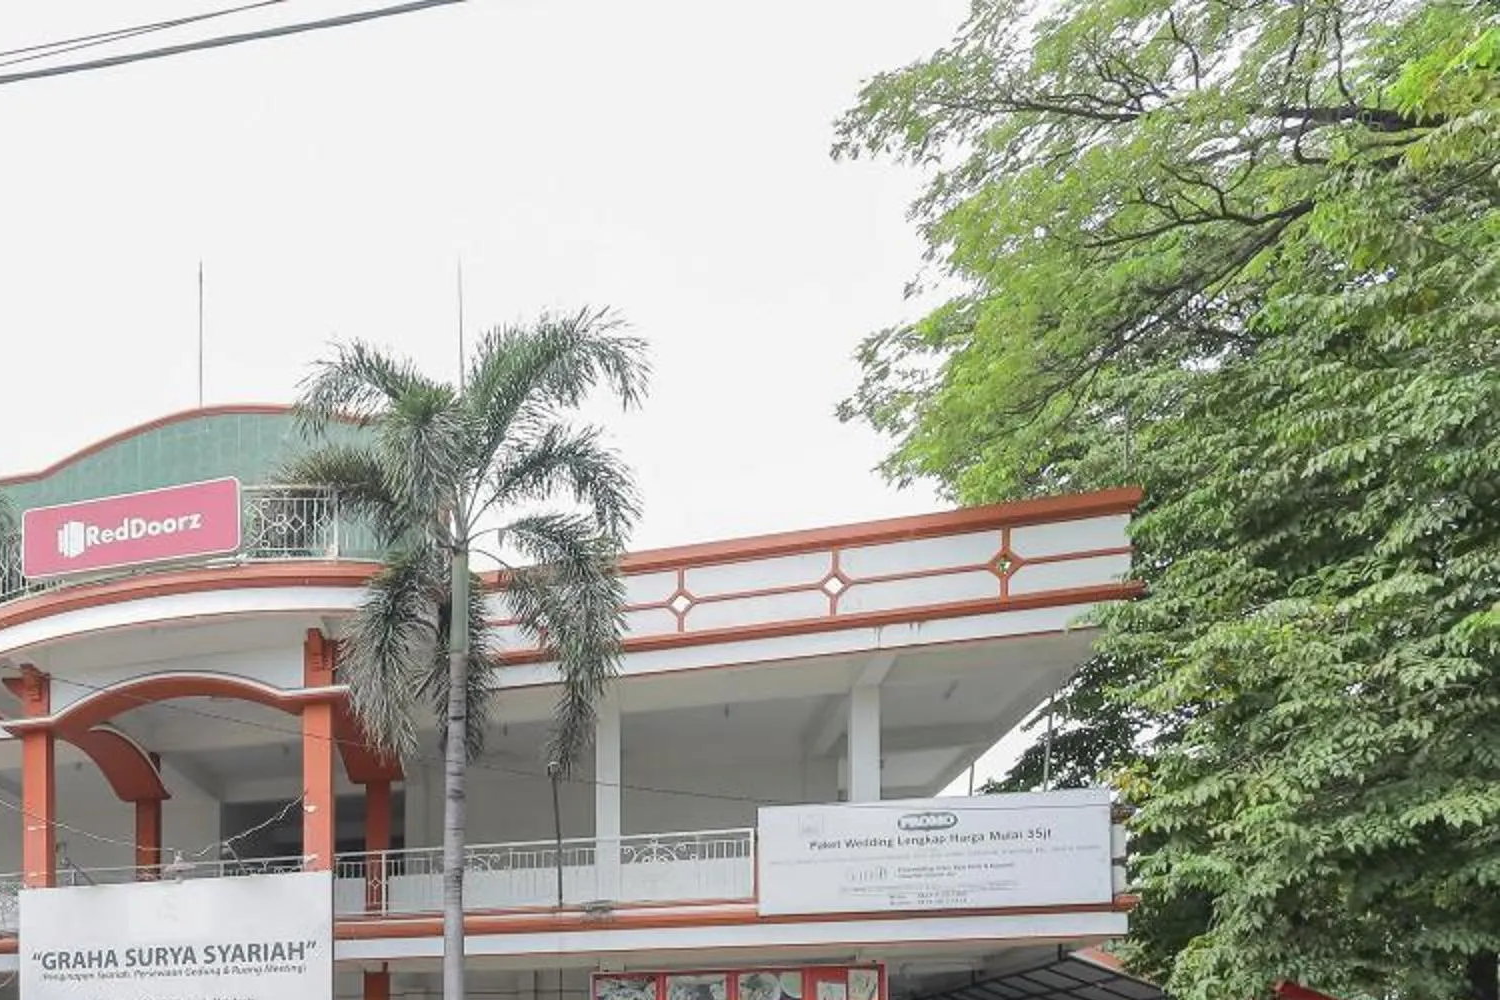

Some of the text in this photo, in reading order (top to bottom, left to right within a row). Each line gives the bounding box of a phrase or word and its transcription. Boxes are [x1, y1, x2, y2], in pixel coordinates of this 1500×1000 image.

[86, 513, 202, 546] RedDoorz
[897, 833, 946, 846] Lengkap
[125, 944, 197, 968] SURYA
